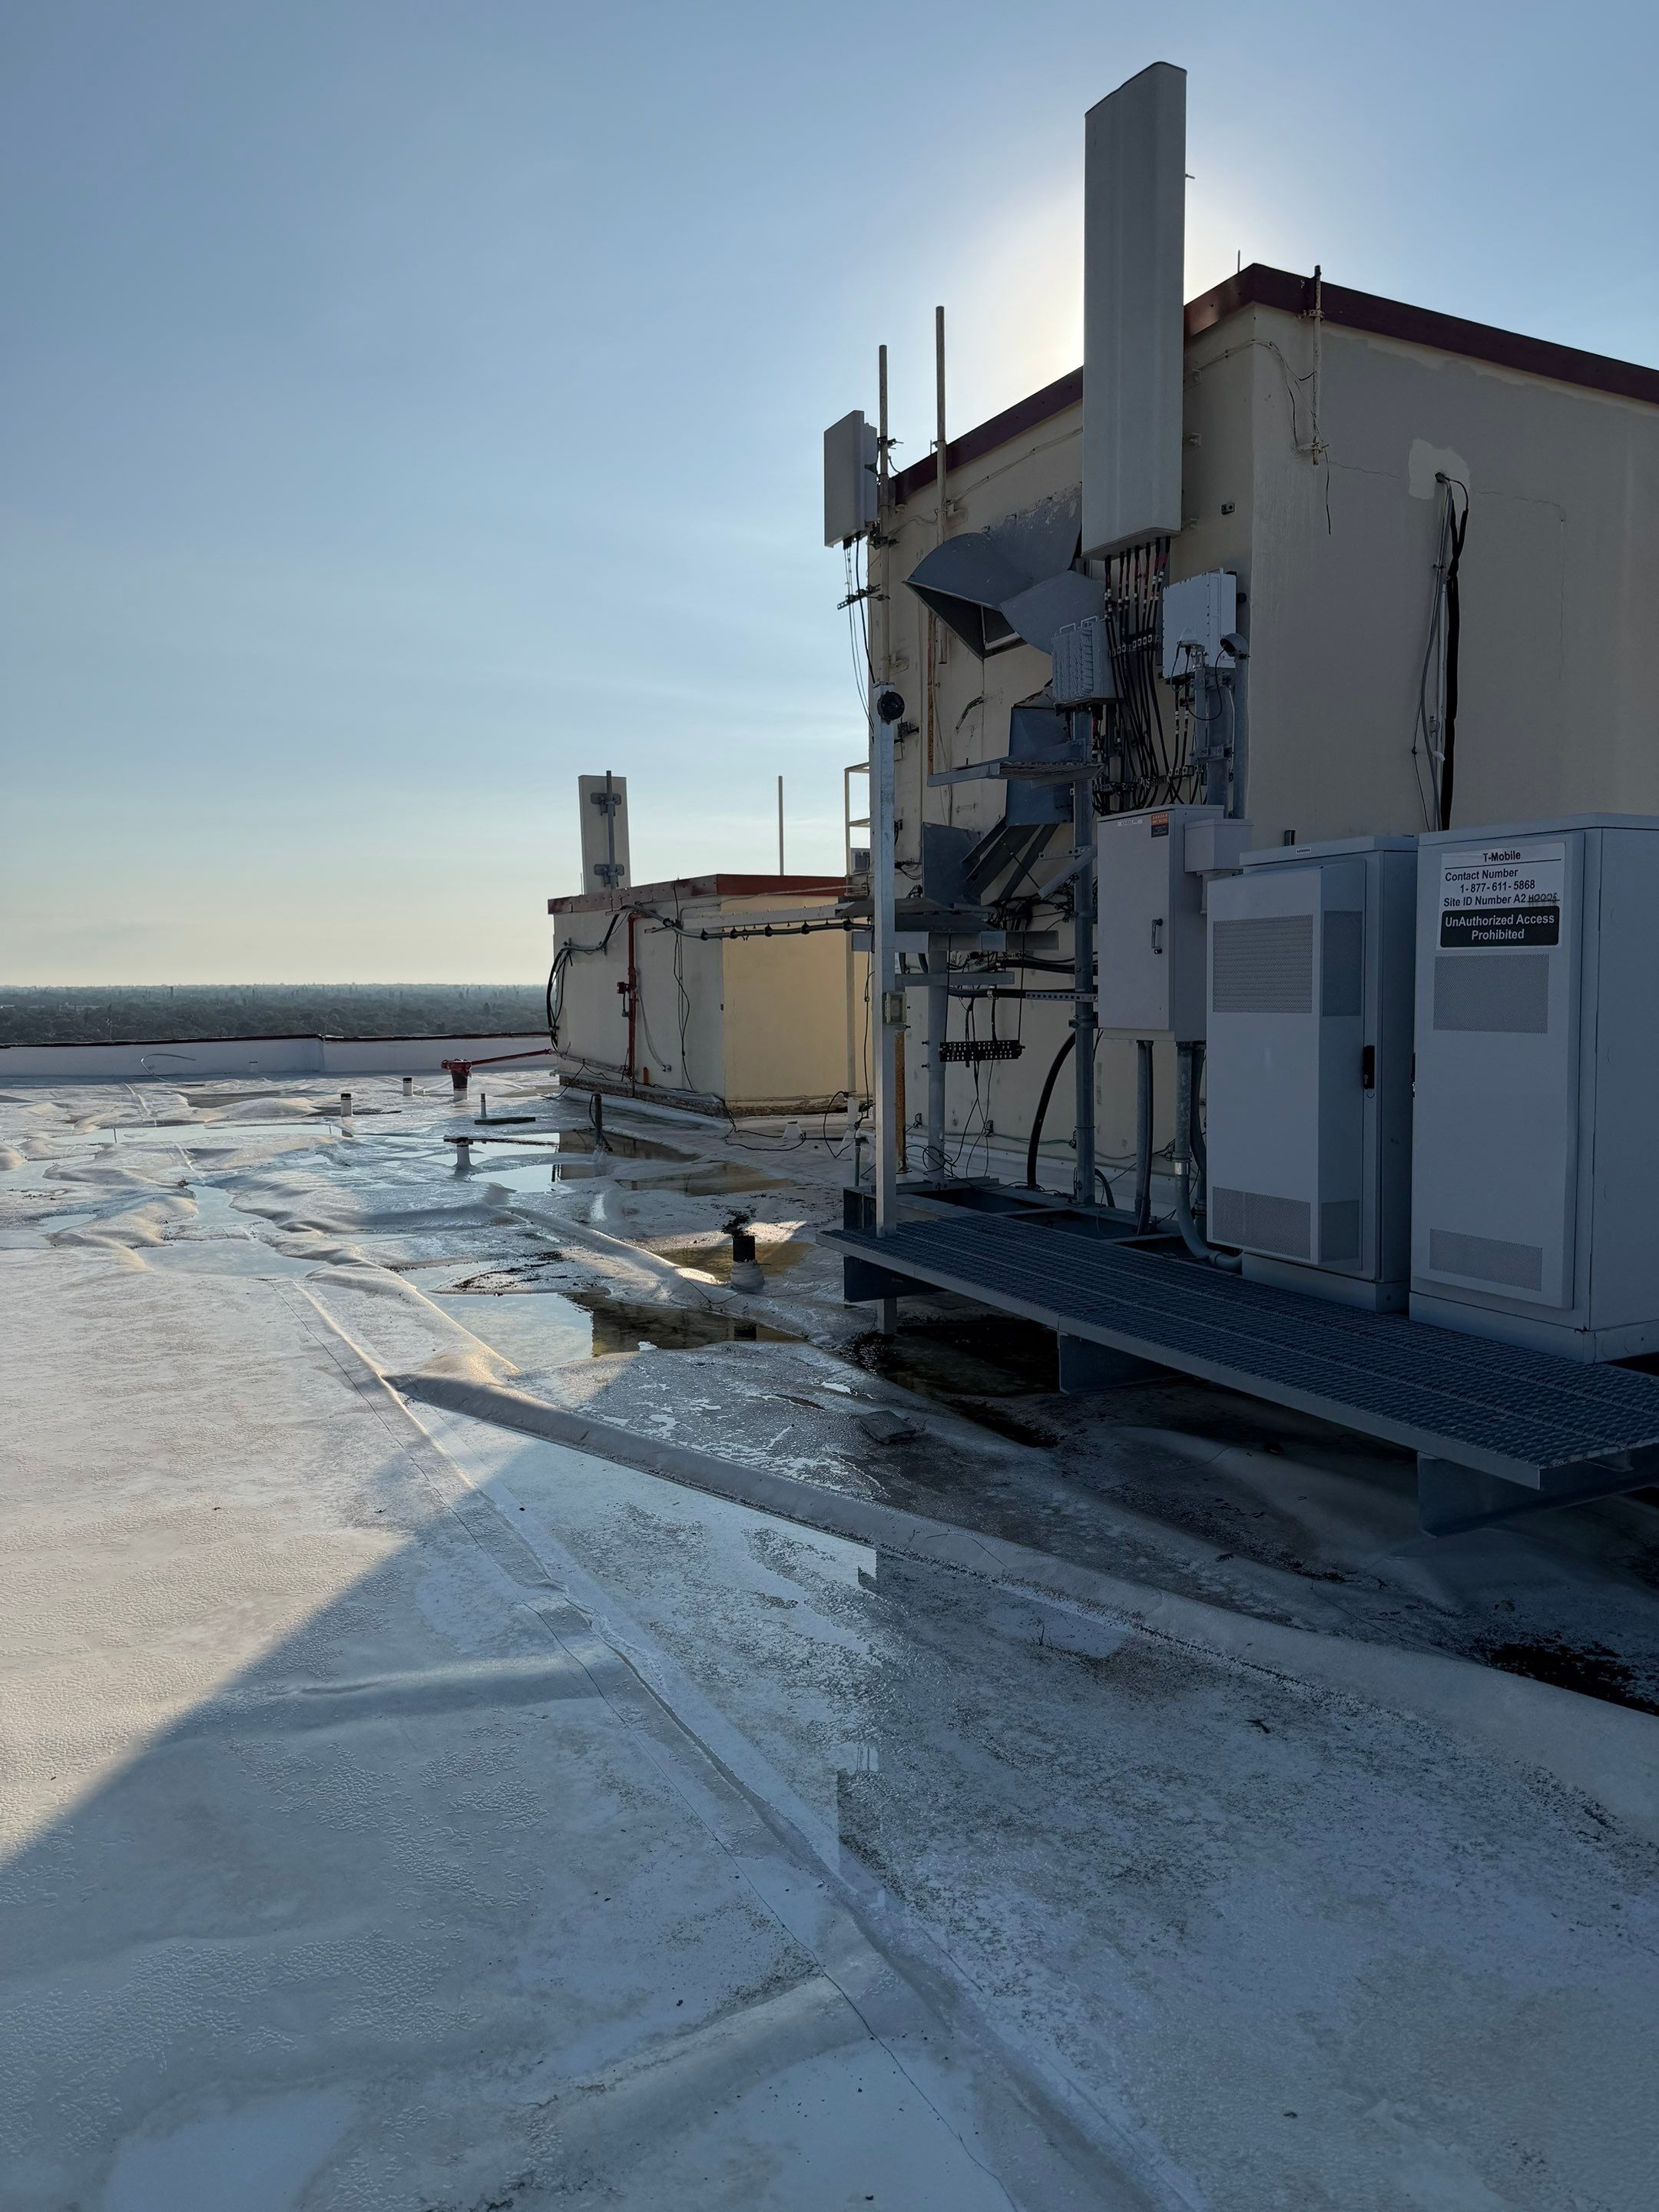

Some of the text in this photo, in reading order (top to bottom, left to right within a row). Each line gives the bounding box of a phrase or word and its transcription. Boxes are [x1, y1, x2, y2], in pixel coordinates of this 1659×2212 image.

[1482, 850, 1521, 863] T-Mobile
[1445, 869, 1518, 882] Contact Number
[1444, 897, 1461, 907] Site
[1463, 896, 1472, 906] ID
[1475, 895, 1512, 905] Number
[1445, 913, 1555, 927] UnAuthorized Access
[1471, 929, 1525, 940] Prohibited
